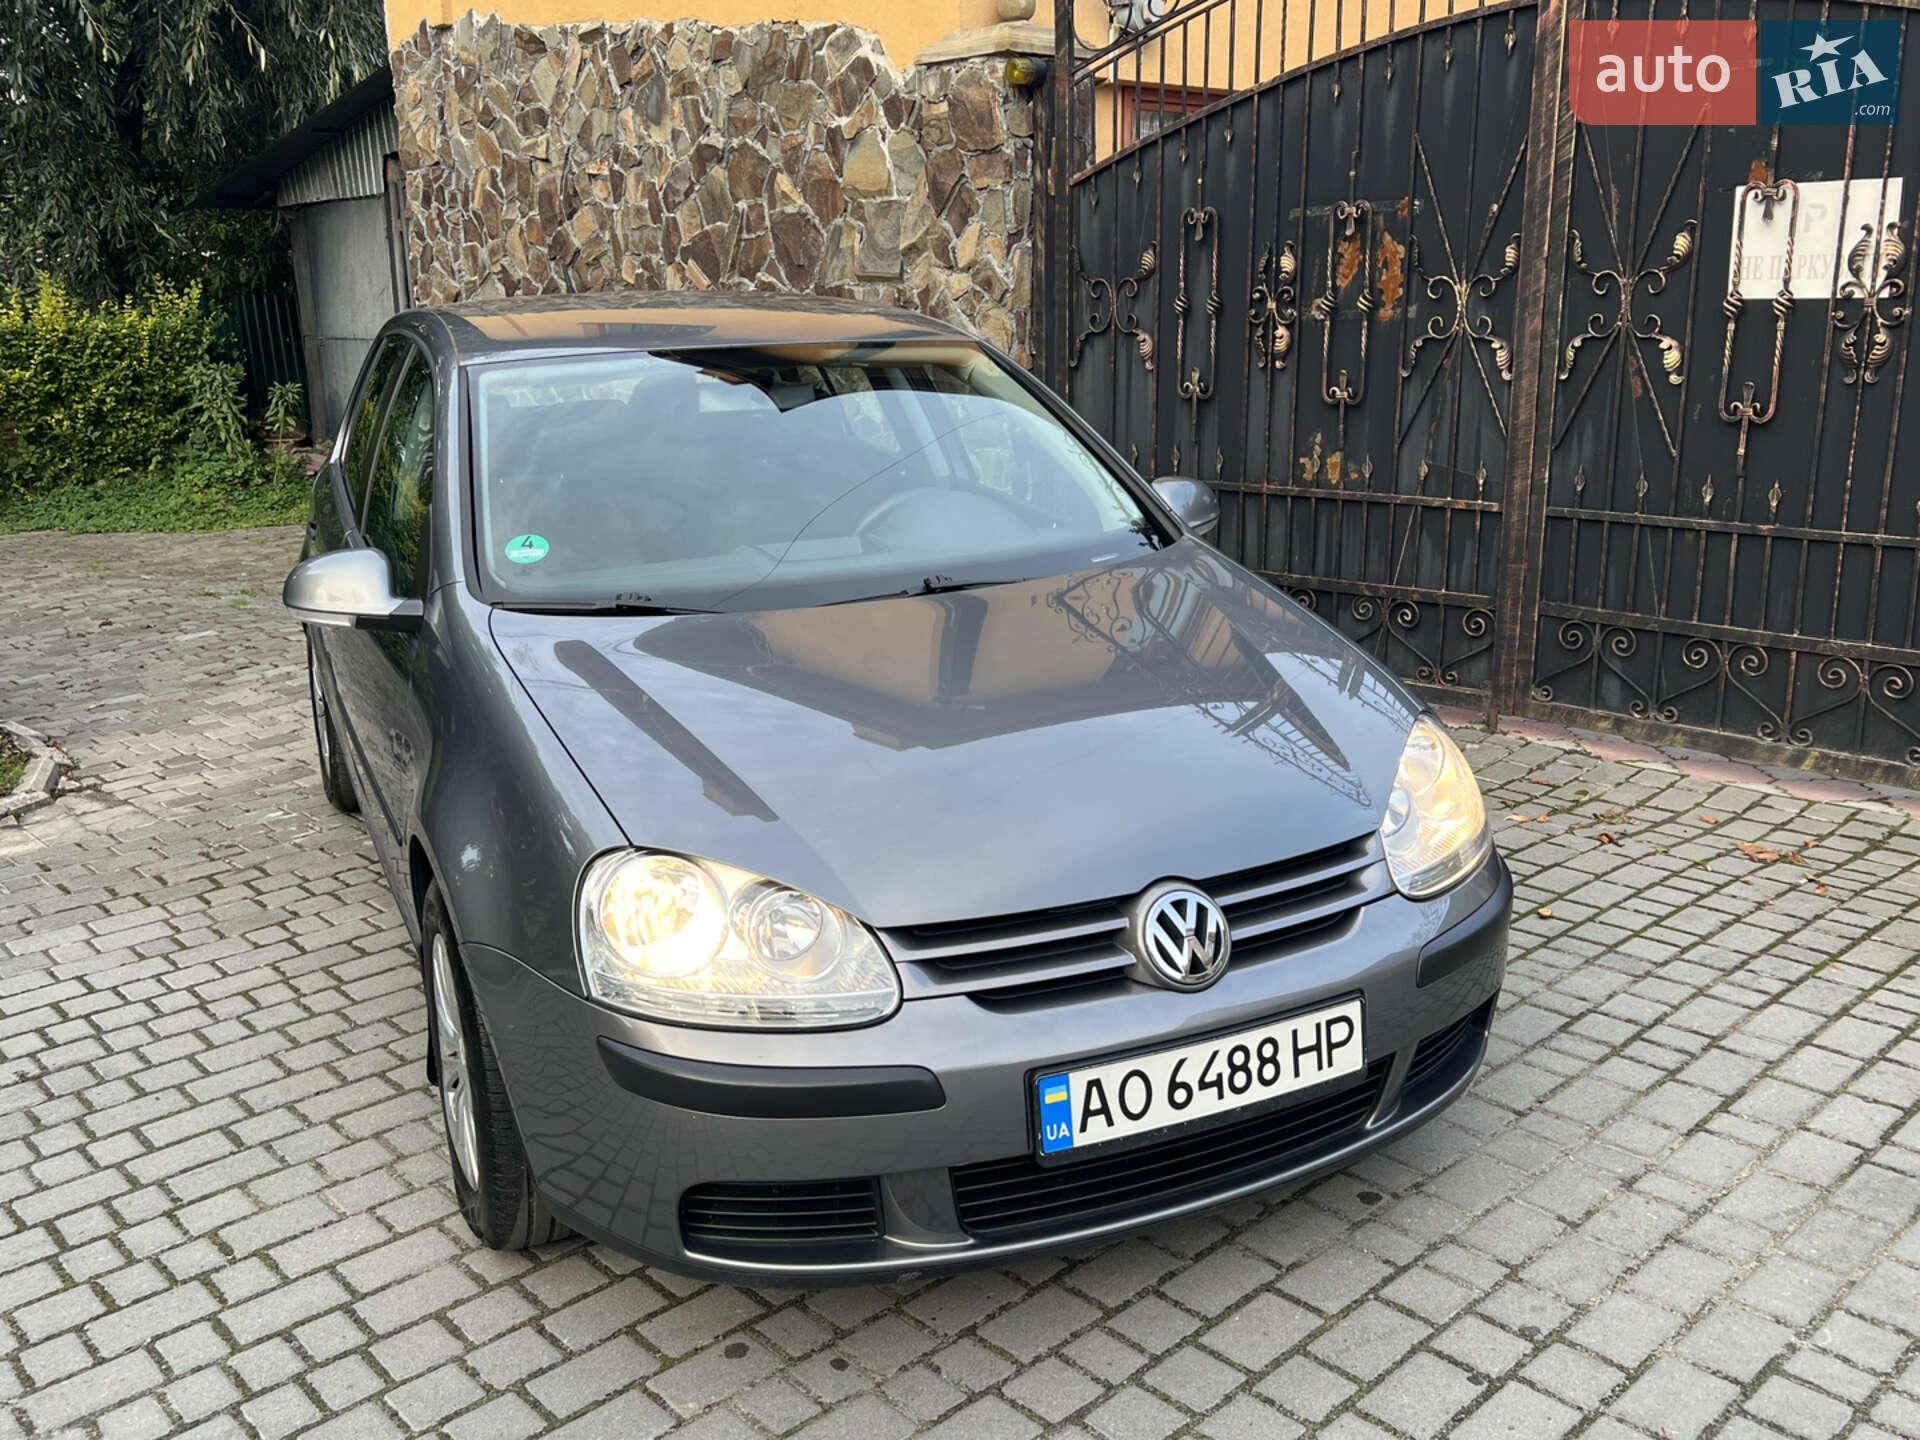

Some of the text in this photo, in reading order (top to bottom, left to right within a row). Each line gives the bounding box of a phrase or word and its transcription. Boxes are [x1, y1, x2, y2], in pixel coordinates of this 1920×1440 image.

[520, 534, 534, 550] 4
[1078, 1014, 1355, 1134] AO 6488 HP
[1045, 1122, 1071, 1142] UA
